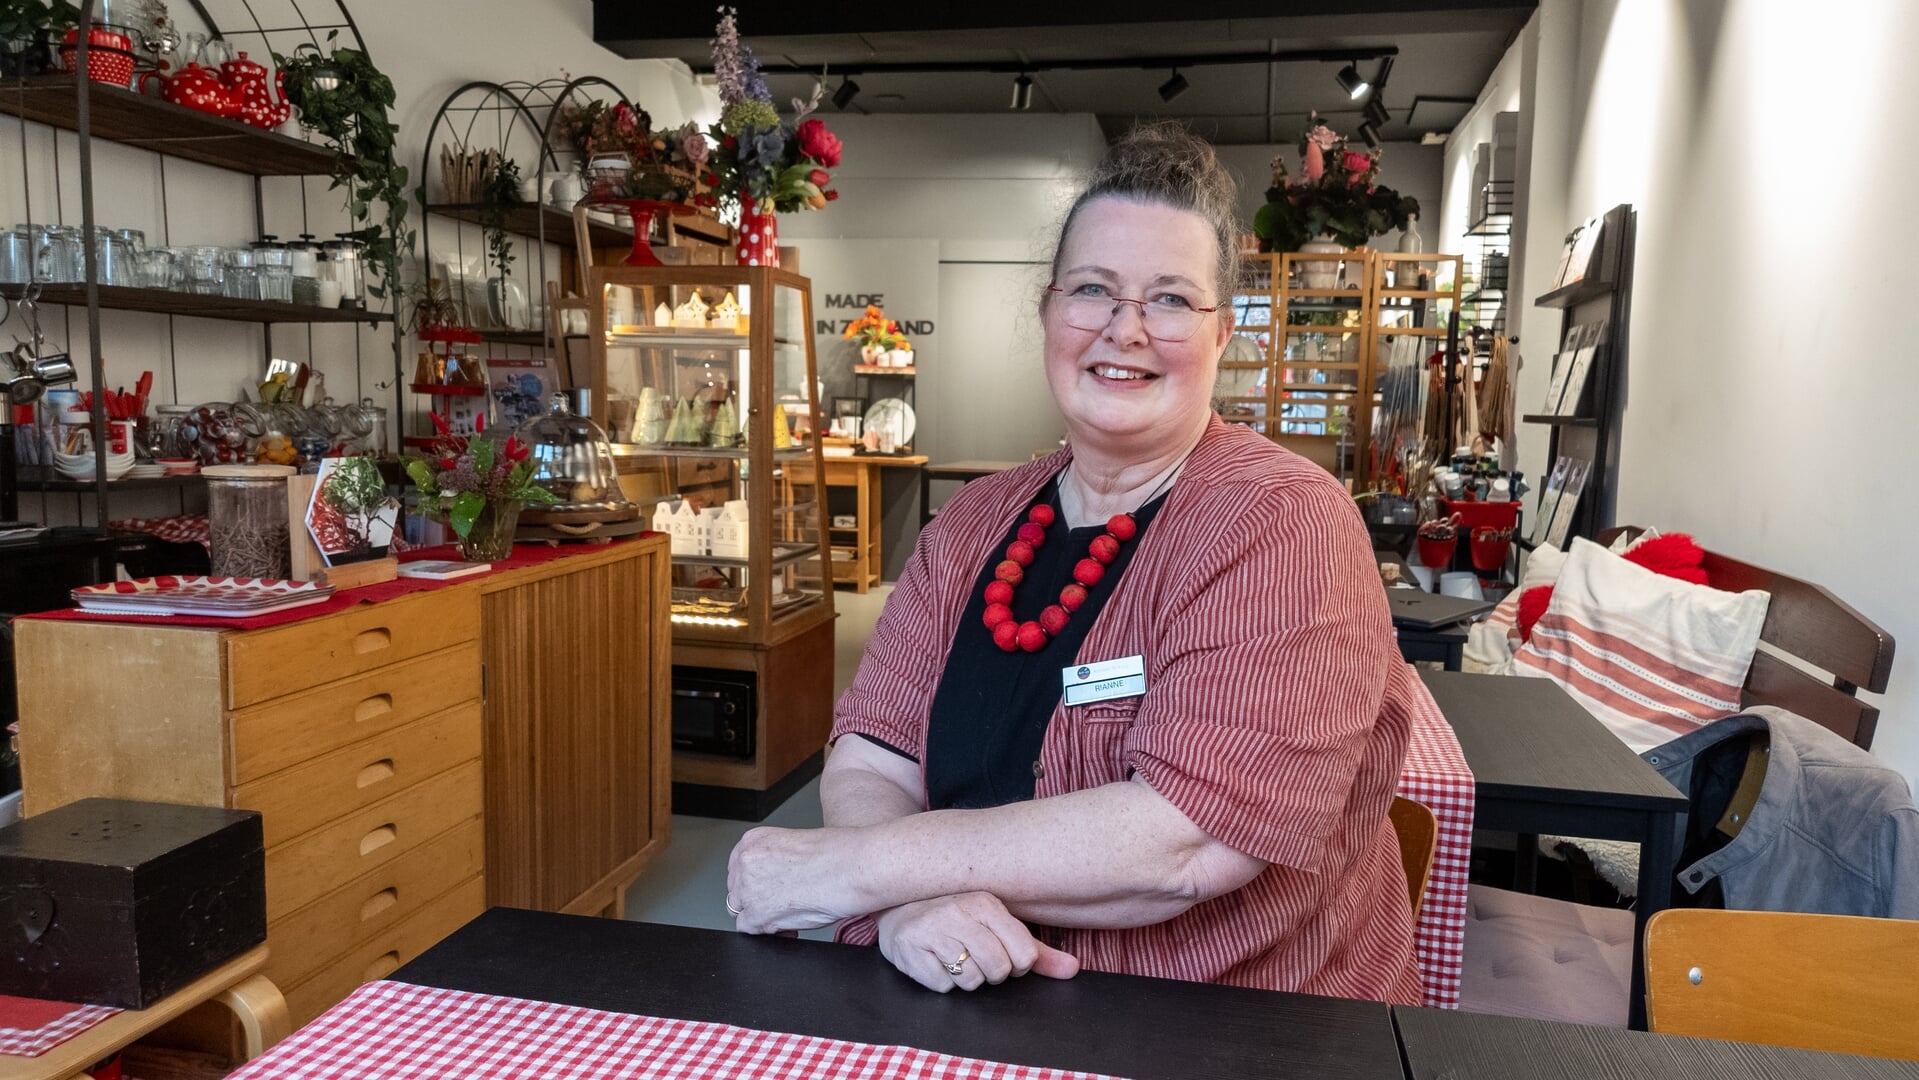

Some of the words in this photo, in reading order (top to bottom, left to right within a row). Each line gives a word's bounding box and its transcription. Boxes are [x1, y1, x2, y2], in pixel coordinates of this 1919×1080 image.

[825, 294, 884, 308] MADE
[817, 320, 835, 334] IN
[840, 320, 935, 335] ZAND
[1095, 680, 1124, 692] RIANNE
